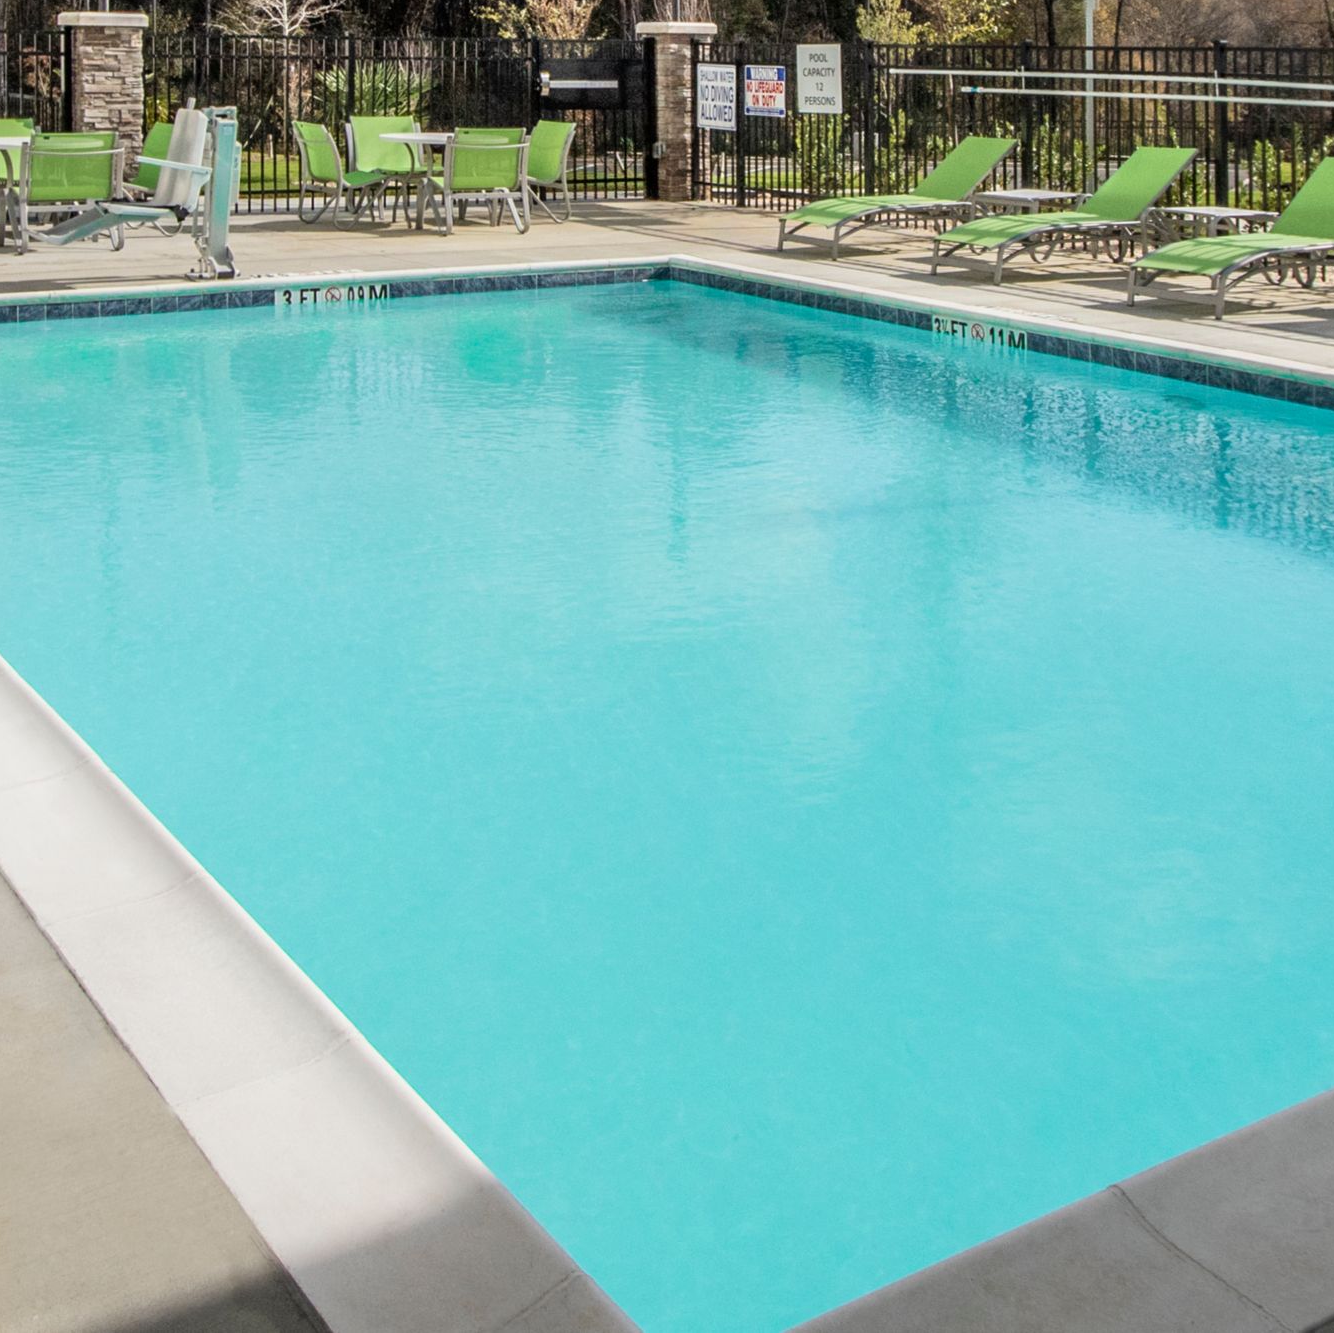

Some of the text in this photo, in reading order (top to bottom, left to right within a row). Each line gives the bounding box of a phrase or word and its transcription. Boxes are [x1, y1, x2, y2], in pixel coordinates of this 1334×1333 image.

[809, 53, 828, 63] POOL
[700, 70, 734, 83] SHALLOW WATER
[803, 67, 835, 77] CAPACITY
[746, 81, 783, 93] NO LIFEGUARD
[815, 82, 824, 91] 12
[700, 85, 734, 103] NO DIVING
[752, 94, 777, 107] ON DUTY
[804, 96, 836, 106] PERSONS
[700, 104, 733, 122] ALLOWED
[283, 289, 292, 305] 3
[300, 288, 320, 304] FT
[951, 320, 968, 339] FT
